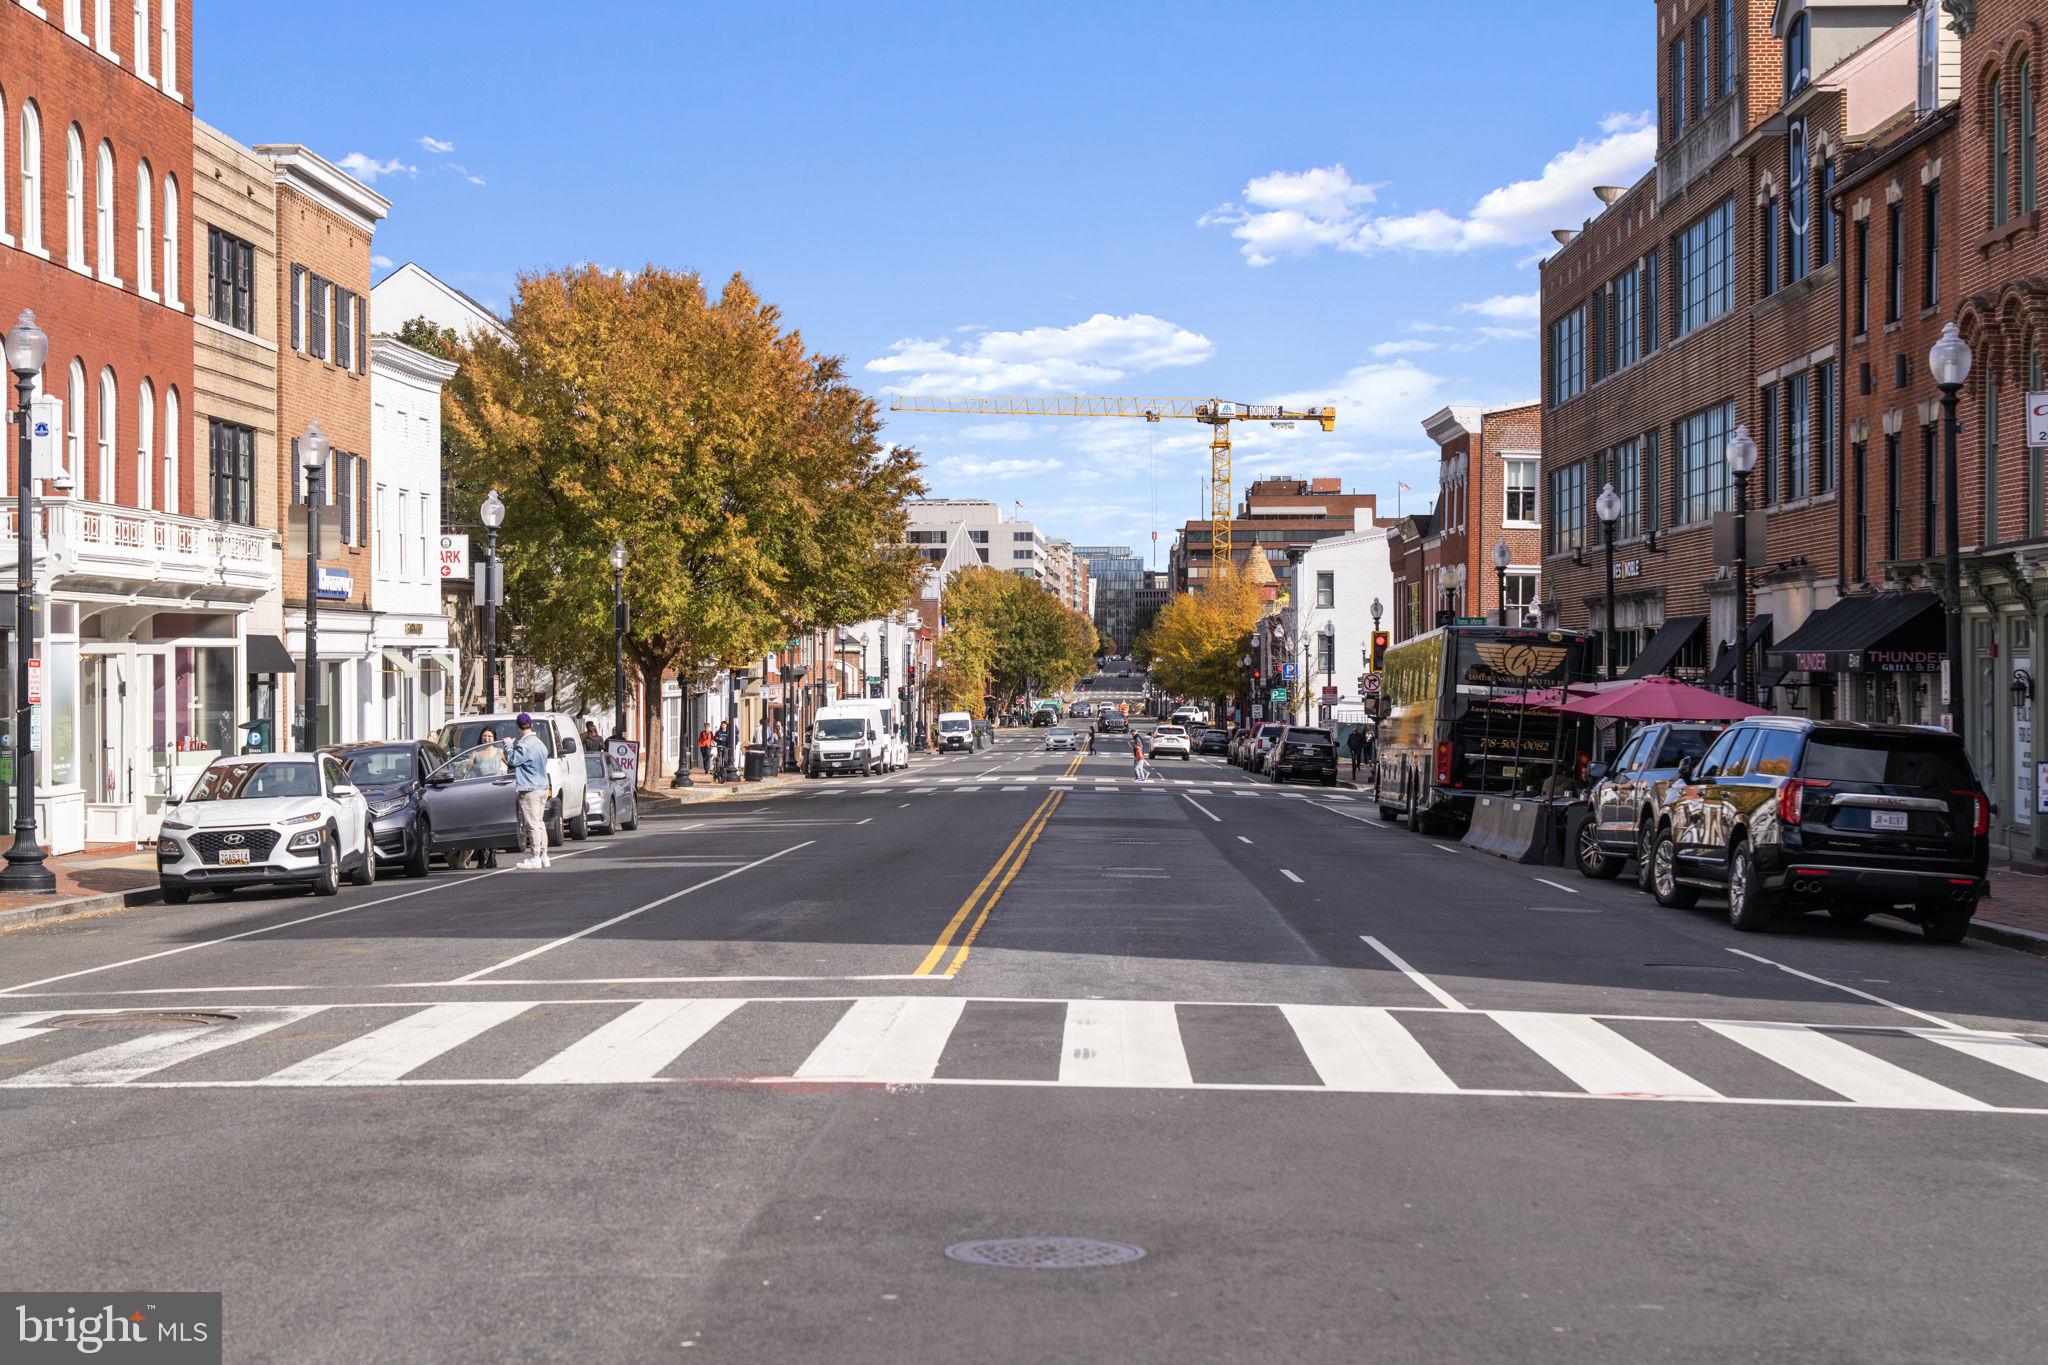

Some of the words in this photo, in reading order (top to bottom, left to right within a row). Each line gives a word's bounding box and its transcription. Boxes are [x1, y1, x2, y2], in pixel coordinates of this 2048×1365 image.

[1248, 405, 1280, 416] DONOHOE
[440, 550, 461, 564] ARK
[1796, 652, 1827, 671] THUNDER
[1868, 651, 1949, 663] THUNDER
[1881, 663, 1912, 672] GRILL
[1915, 663, 1926, 672] &
[1926, 663, 1942, 672] BA
[251, 732, 260, 745] P
